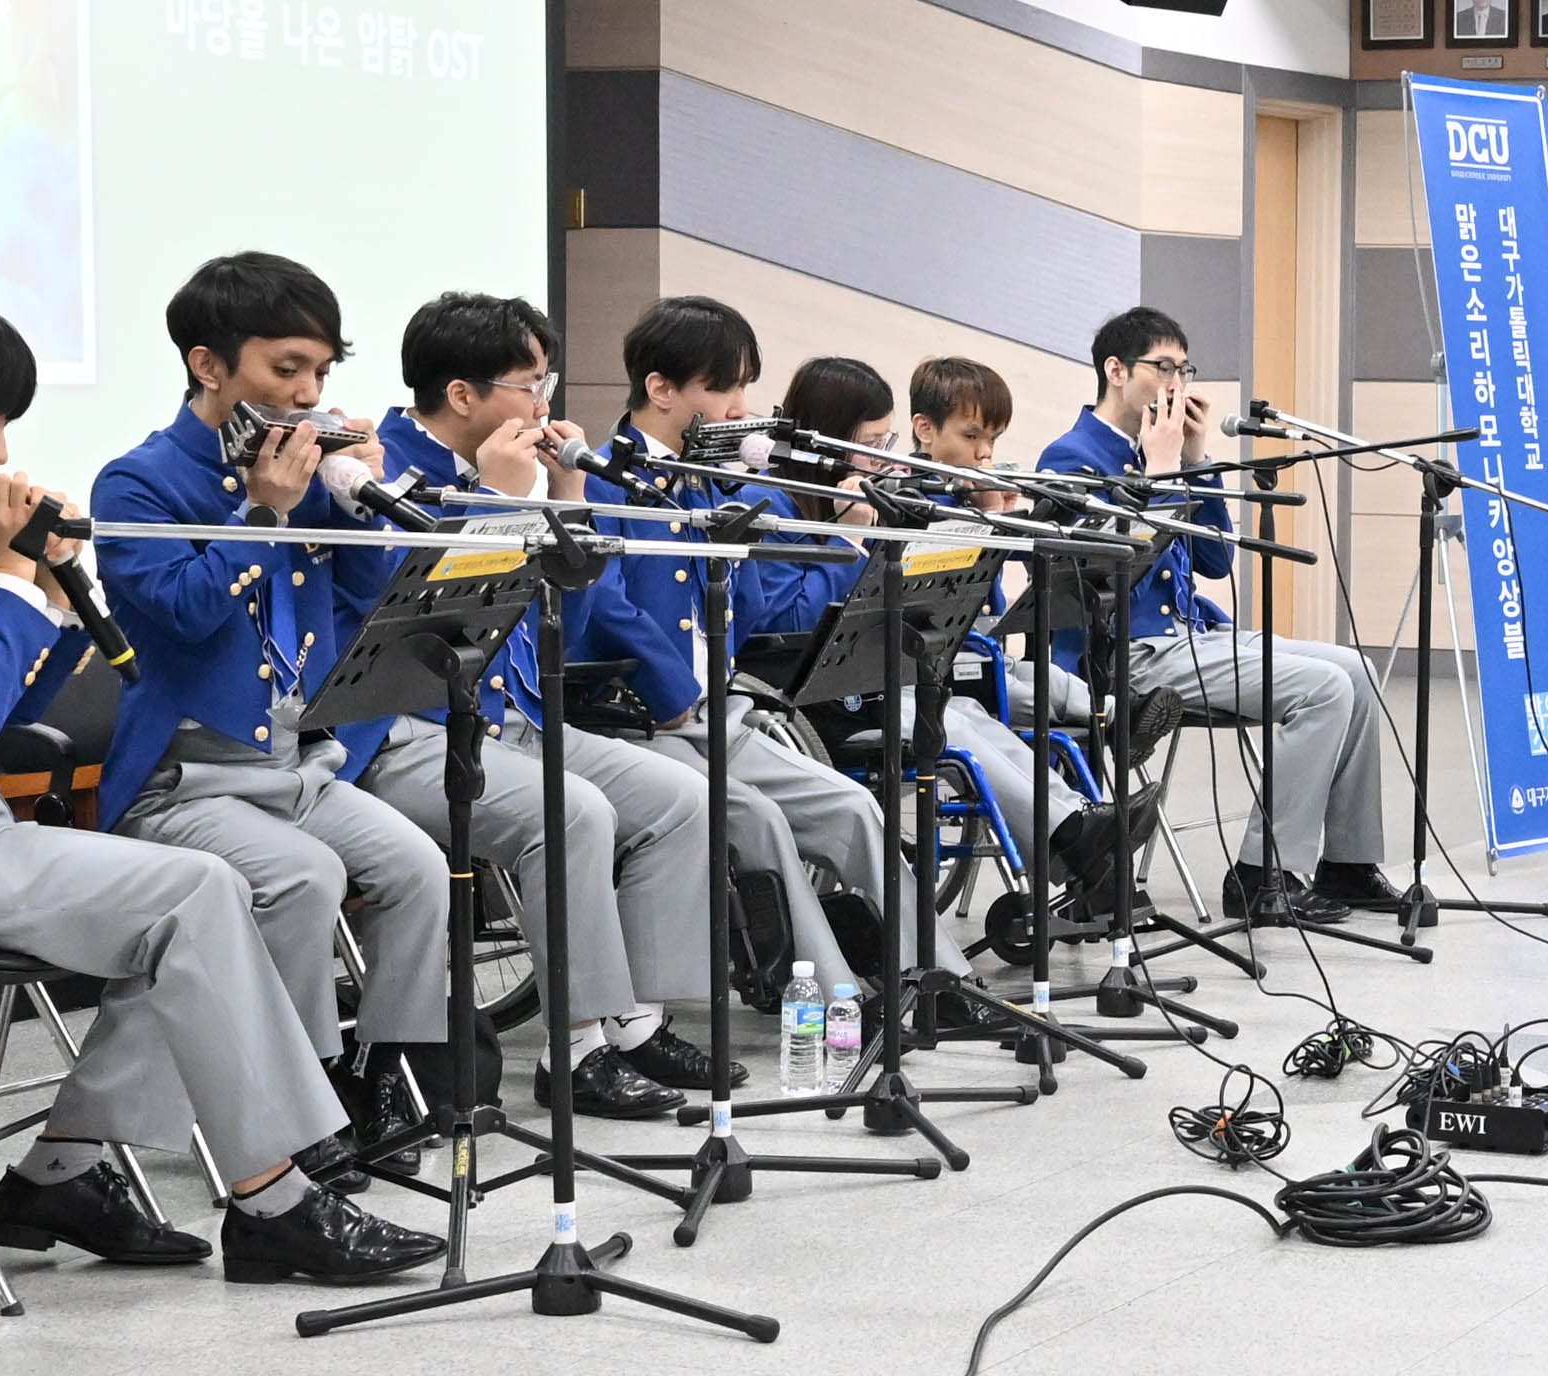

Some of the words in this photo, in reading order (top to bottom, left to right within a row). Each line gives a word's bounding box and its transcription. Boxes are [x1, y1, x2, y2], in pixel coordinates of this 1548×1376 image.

[281, 0, 345, 69] 나온
[357, 9, 419, 79] 암탉
[427, 28, 485, 81] OST
[1445, 120, 1510, 165] DCU
[1498, 206, 1544, 471] 대구가톨릭대학교
[1439, 1111, 1487, 1135] EWI
